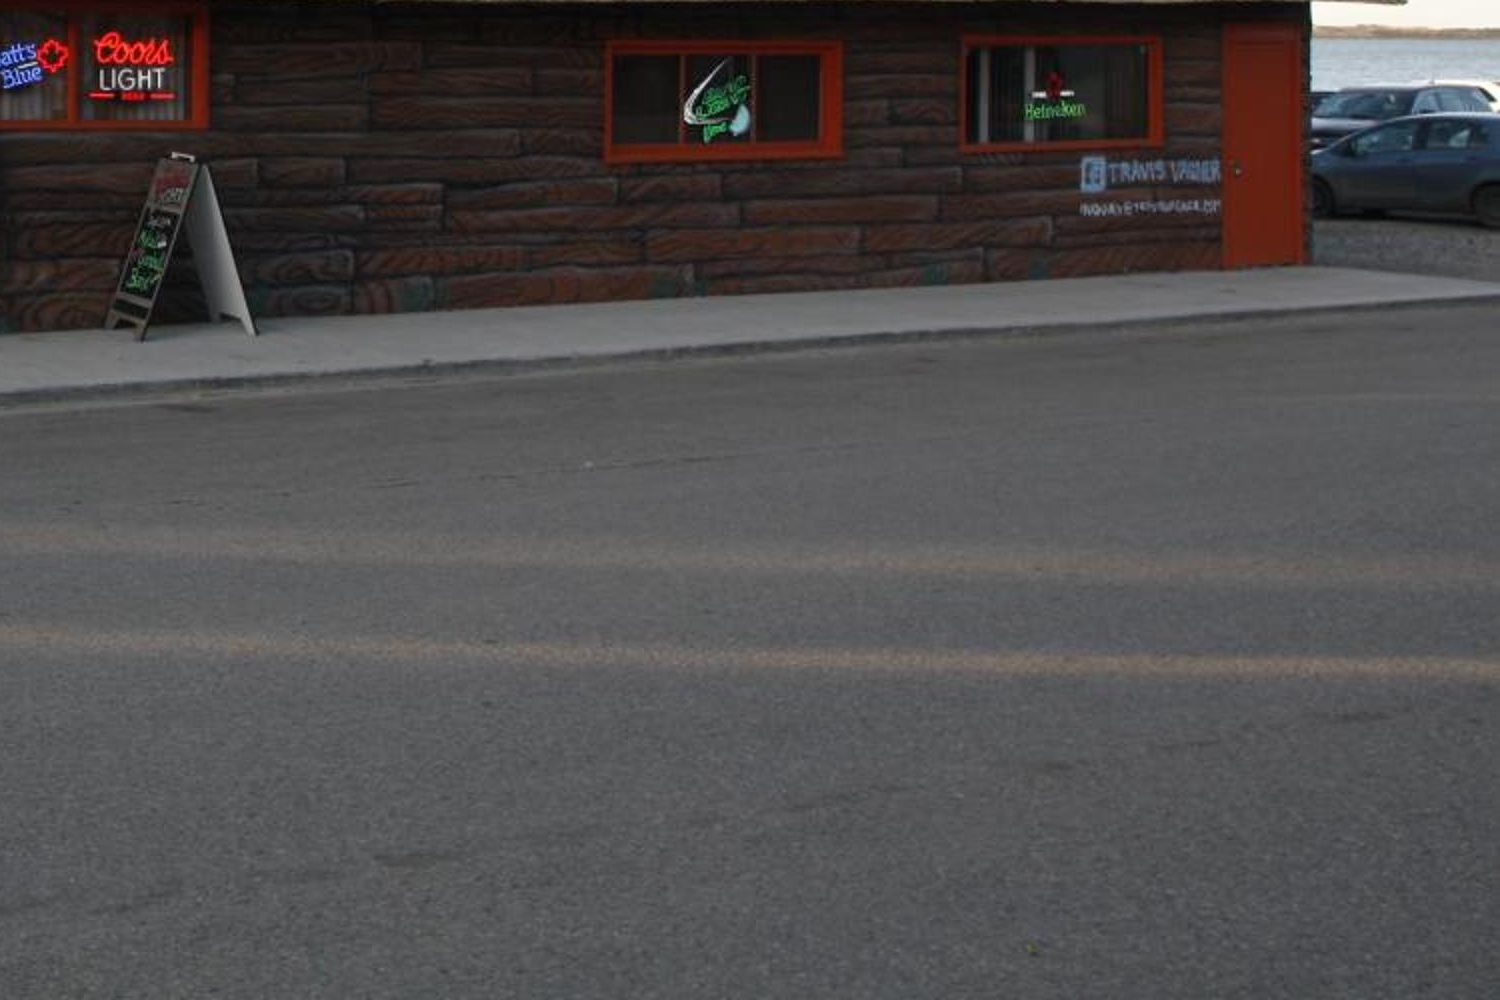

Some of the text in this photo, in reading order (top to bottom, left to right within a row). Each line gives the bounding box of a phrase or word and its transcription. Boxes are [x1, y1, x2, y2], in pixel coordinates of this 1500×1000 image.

[95, 31, 175, 65] Coors
[2, 65, 44, 89] Blue
[100, 68, 165, 91] LIGHT
[1025, 101, 1086, 121] Heineken
